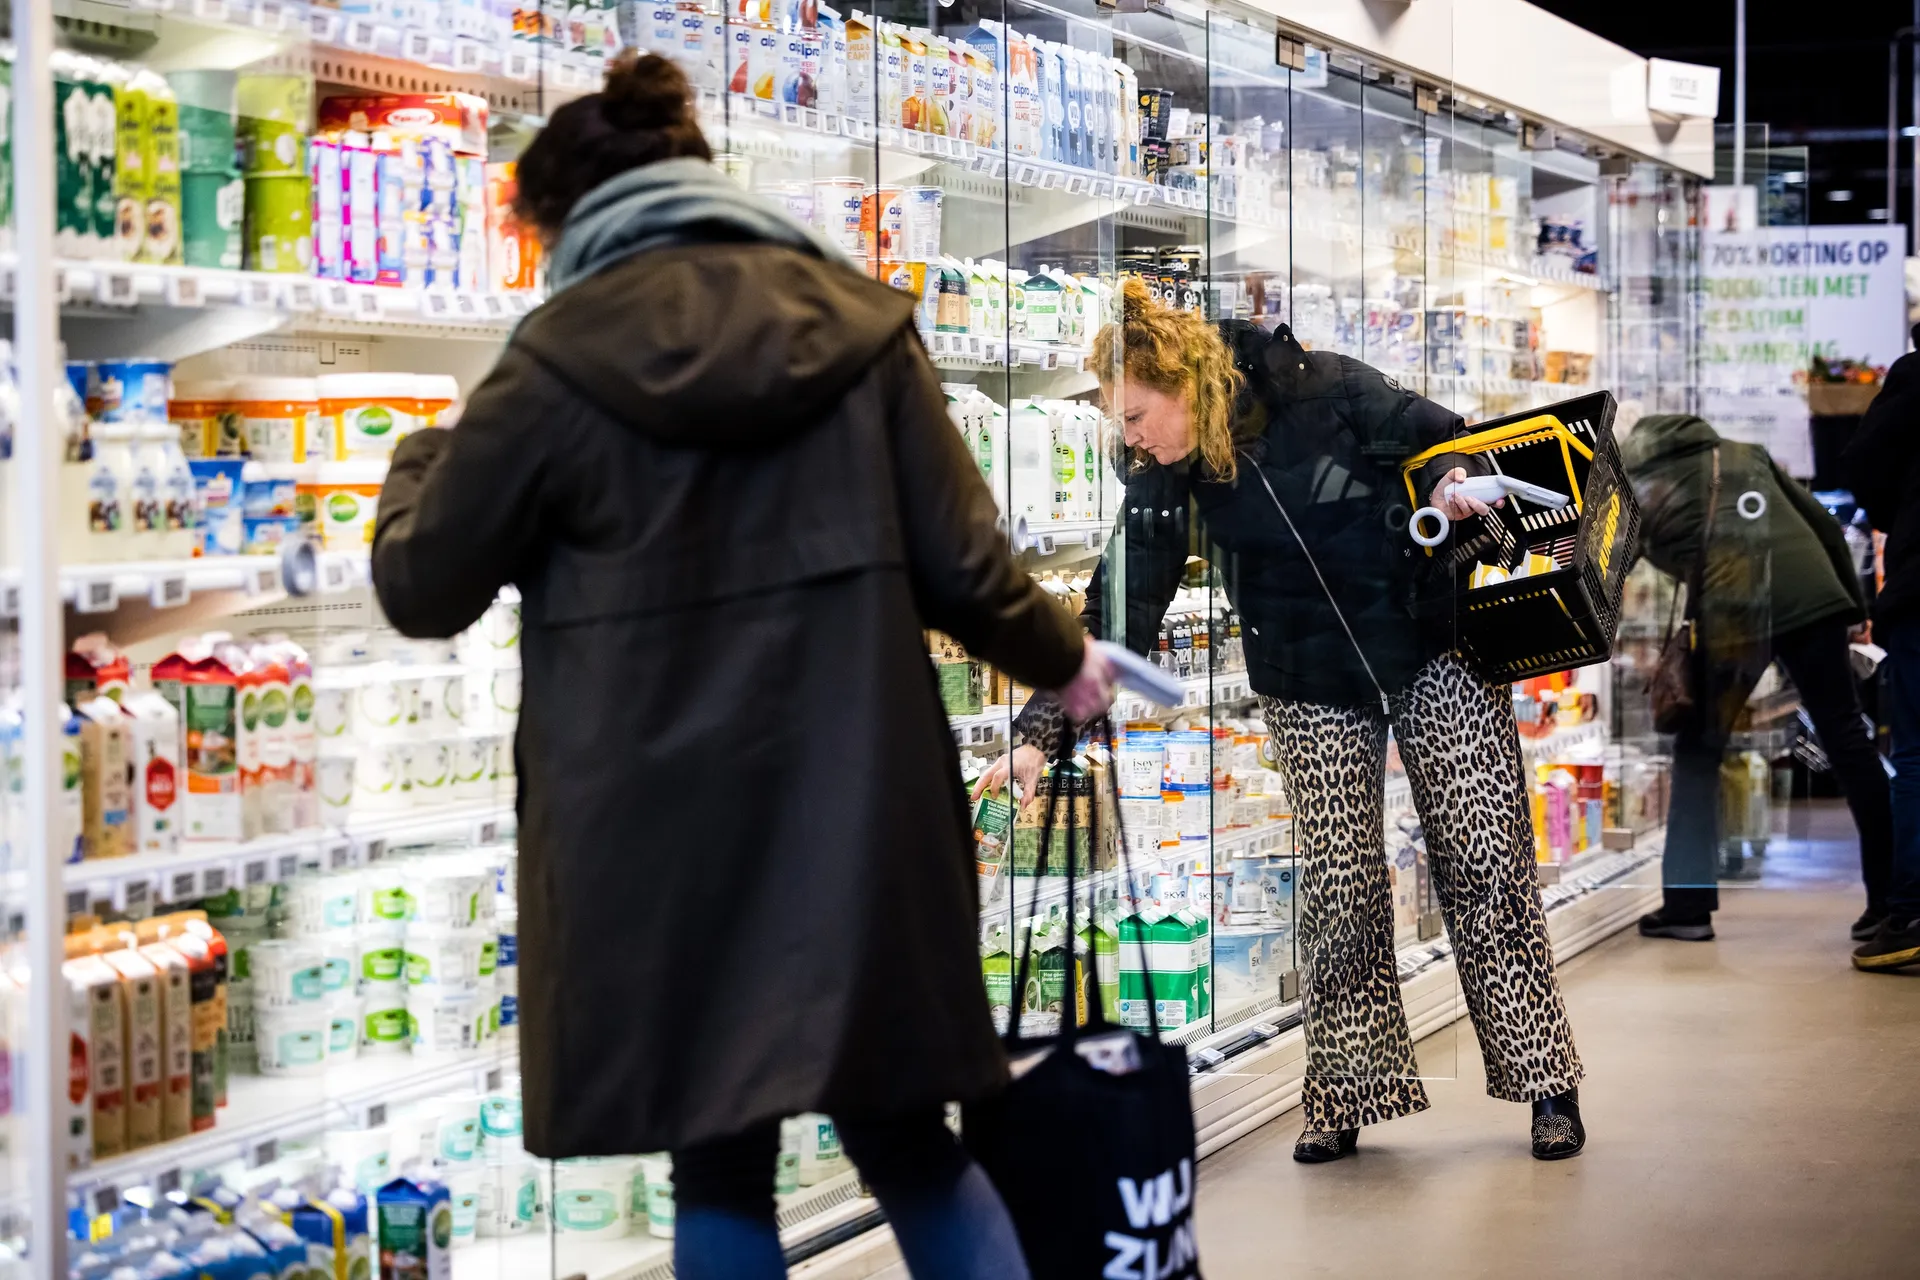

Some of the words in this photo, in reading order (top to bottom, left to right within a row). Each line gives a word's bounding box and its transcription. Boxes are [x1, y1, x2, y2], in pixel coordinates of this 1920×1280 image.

[1013, 81, 1030, 98] alpro
[1858, 240, 1889, 263] OP
[1824, 274, 1870, 298] MET
[1599, 493, 1620, 580] JUMBO
[1164, 890, 1186, 900] SKYR
[1077, 979, 1085, 1024] DEELPAK
